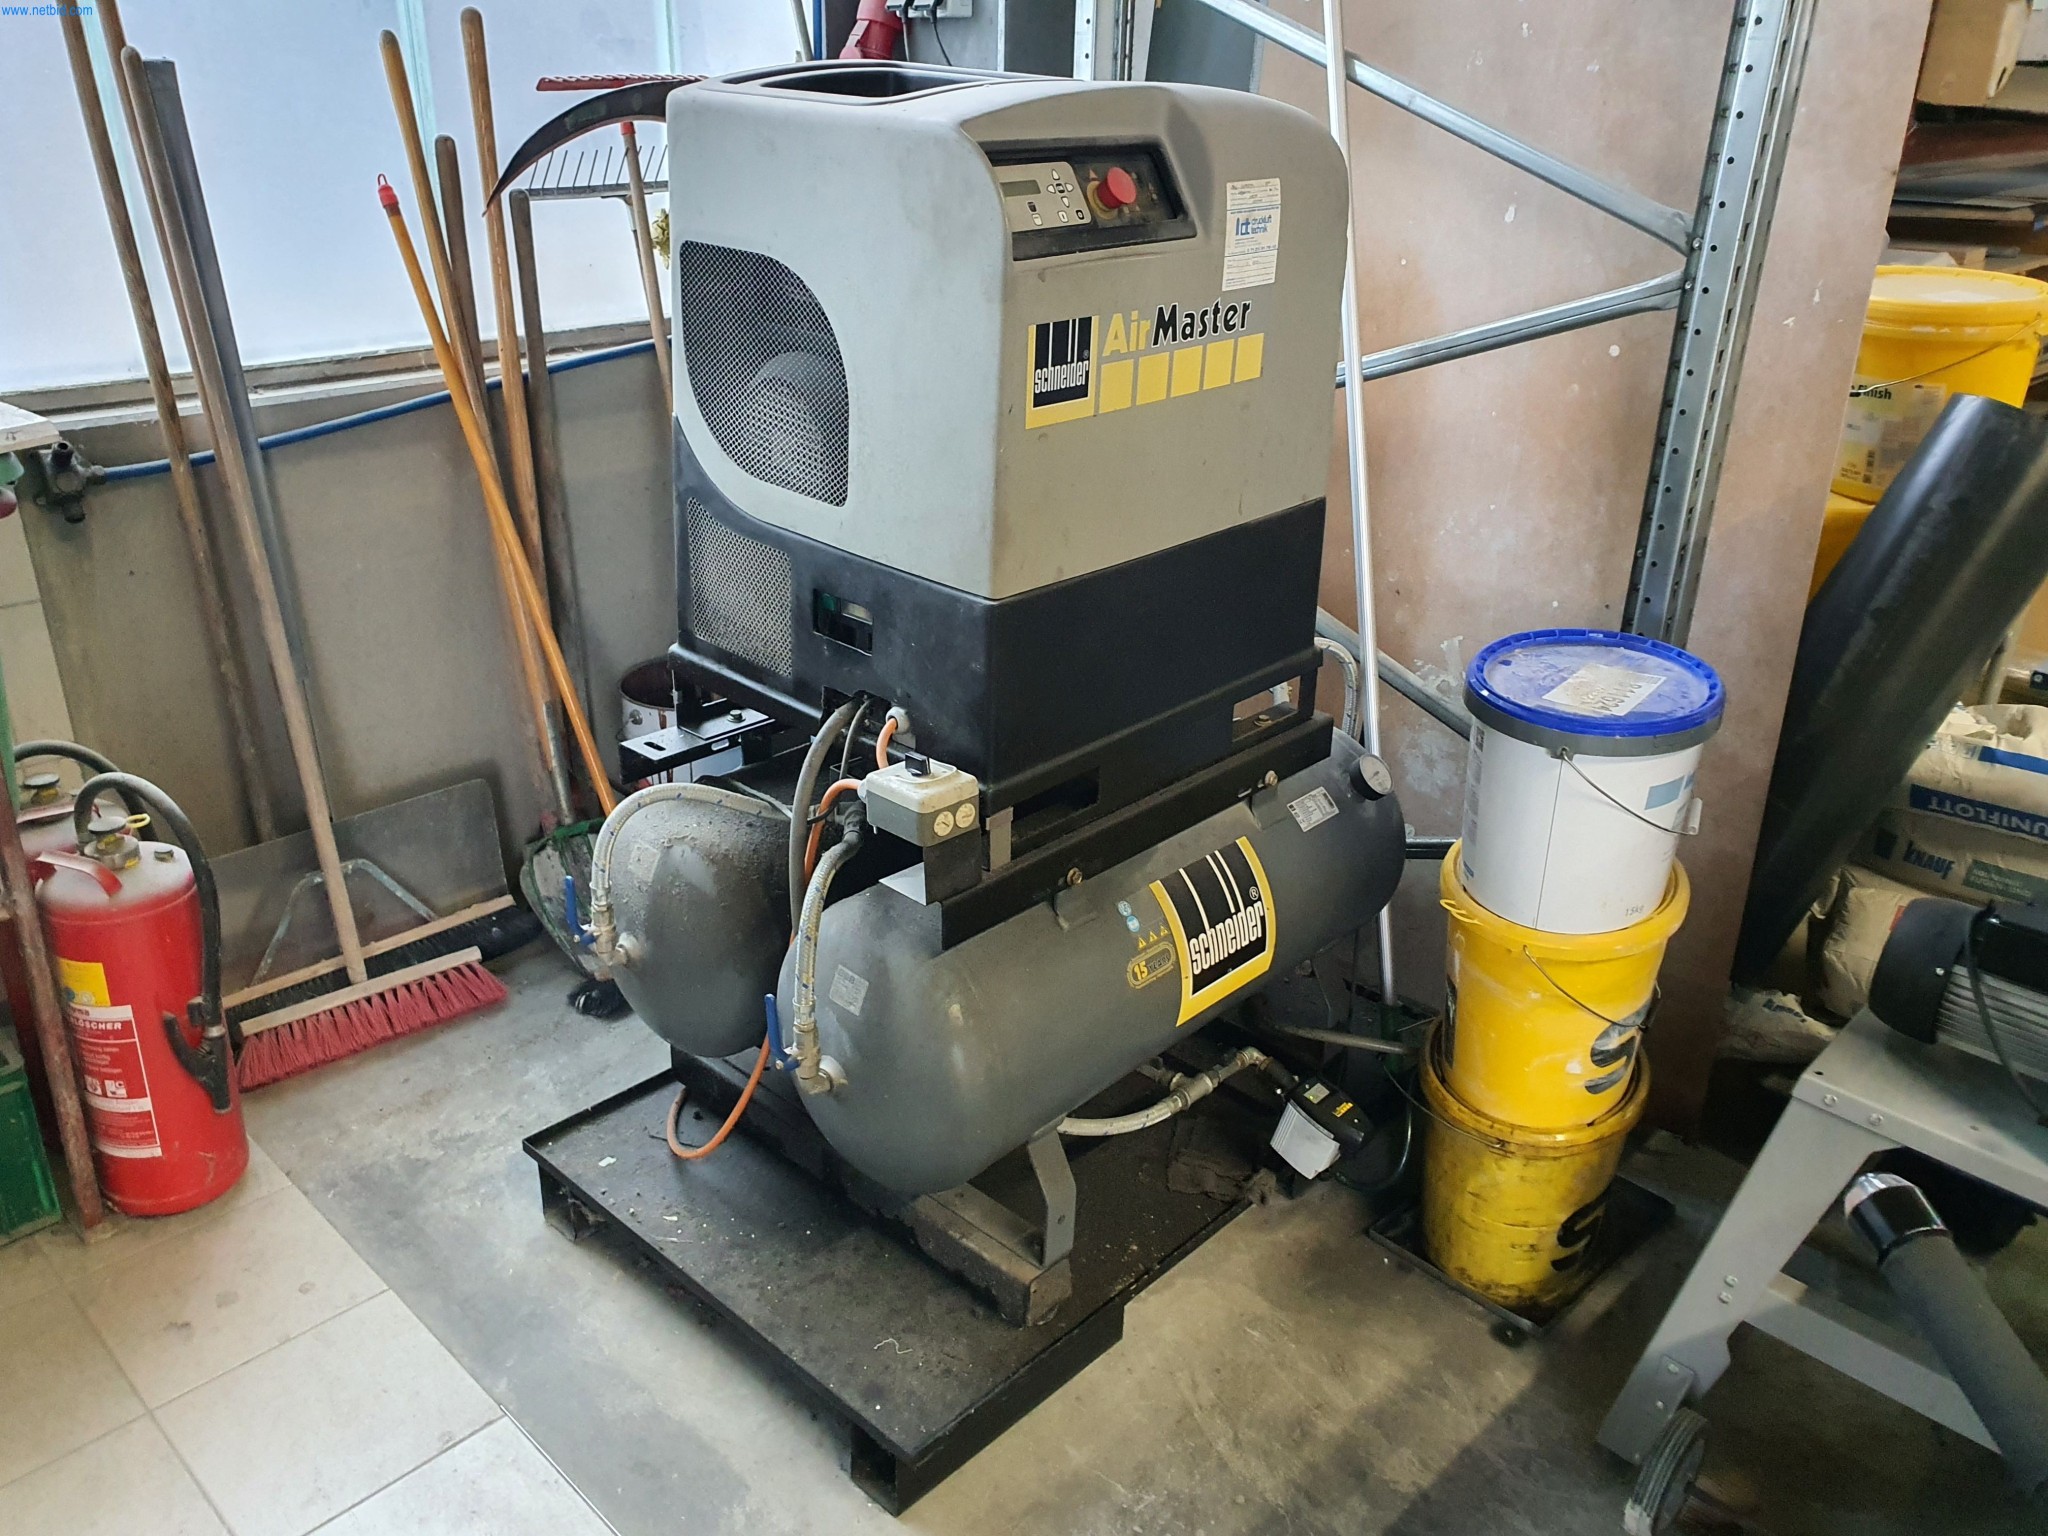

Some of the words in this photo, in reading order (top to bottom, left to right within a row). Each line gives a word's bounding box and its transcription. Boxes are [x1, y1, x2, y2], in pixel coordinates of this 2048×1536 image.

[1101, 309, 1151, 357] Air
[1151, 297, 1252, 349] Master
[1033, 352, 1090, 394] schneider
[1926, 796, 2048, 838] UNIFLOTT
[1188, 899, 1264, 975] schneider
[1133, 960, 1149, 982] 15
